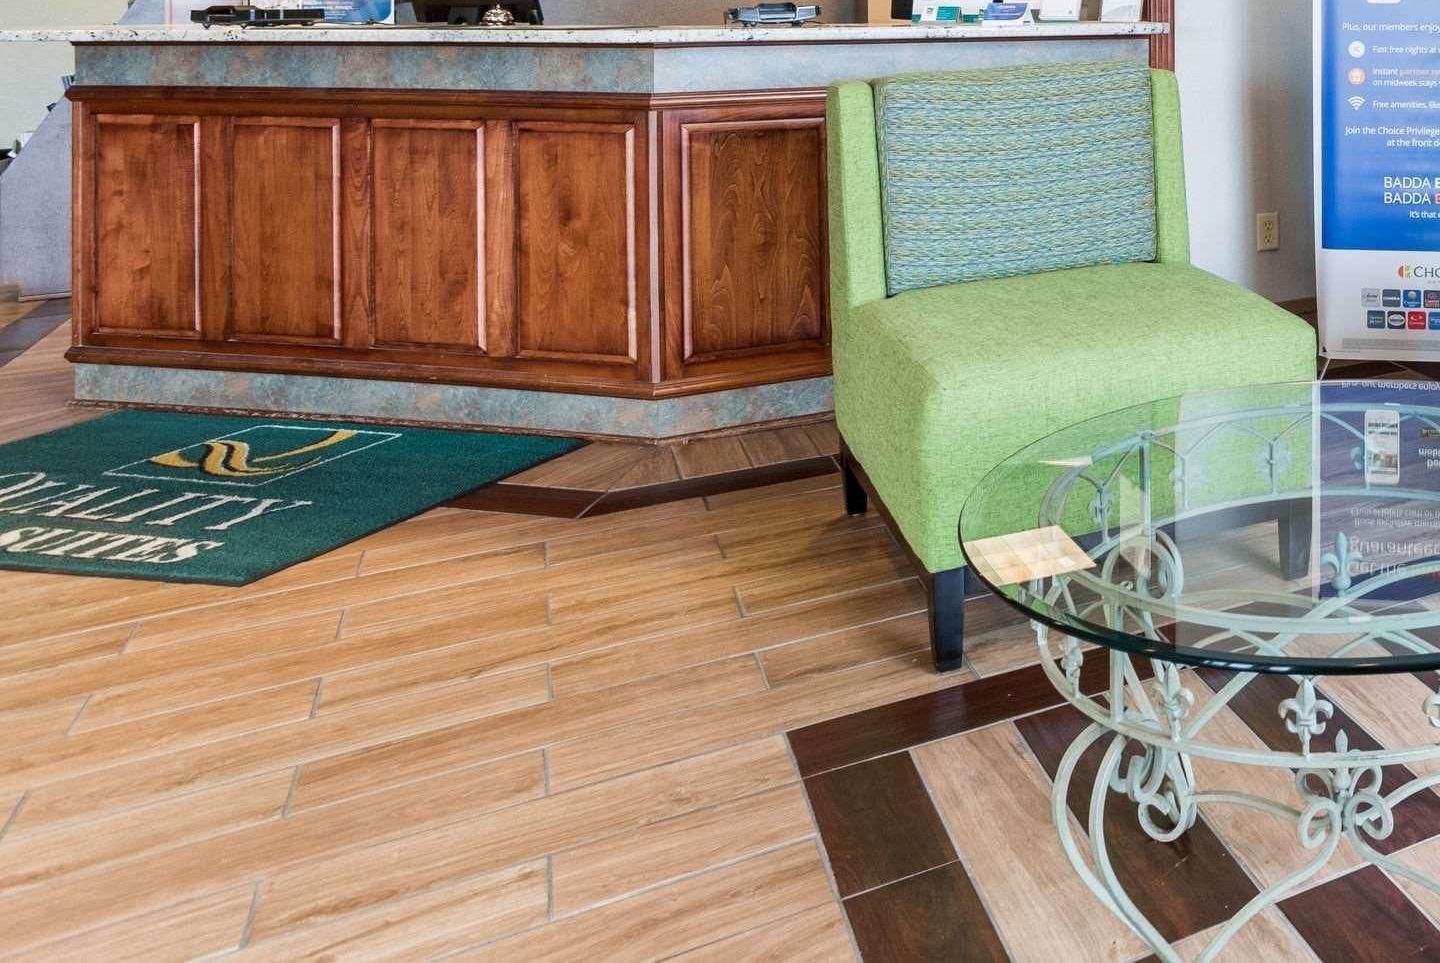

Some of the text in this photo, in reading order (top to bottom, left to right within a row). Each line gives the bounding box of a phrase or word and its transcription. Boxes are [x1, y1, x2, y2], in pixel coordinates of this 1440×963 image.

[1342, 23, 1361, 32] Plus,
[1379, 23, 1418, 31] members
[1389, 46, 1404, 54] free
[1384, 79, 1417, 87] midweek
[1373, 100, 1389, 109] Free
[1344, 126, 1361, 136] Join
[1362, 126, 1376, 135] the
[1377, 126, 1406, 135] Choice
[1387, 139, 1396, 147] at
[1396, 139, 1411, 147] the
[1412, 139, 1432, 147] front
[1383, 177, 1431, 189] BADDA
[1383, 192, 1431, 204] BADDA
[1409, 210, 1419, 219] It's
[1421, 210, 1436, 219] that
